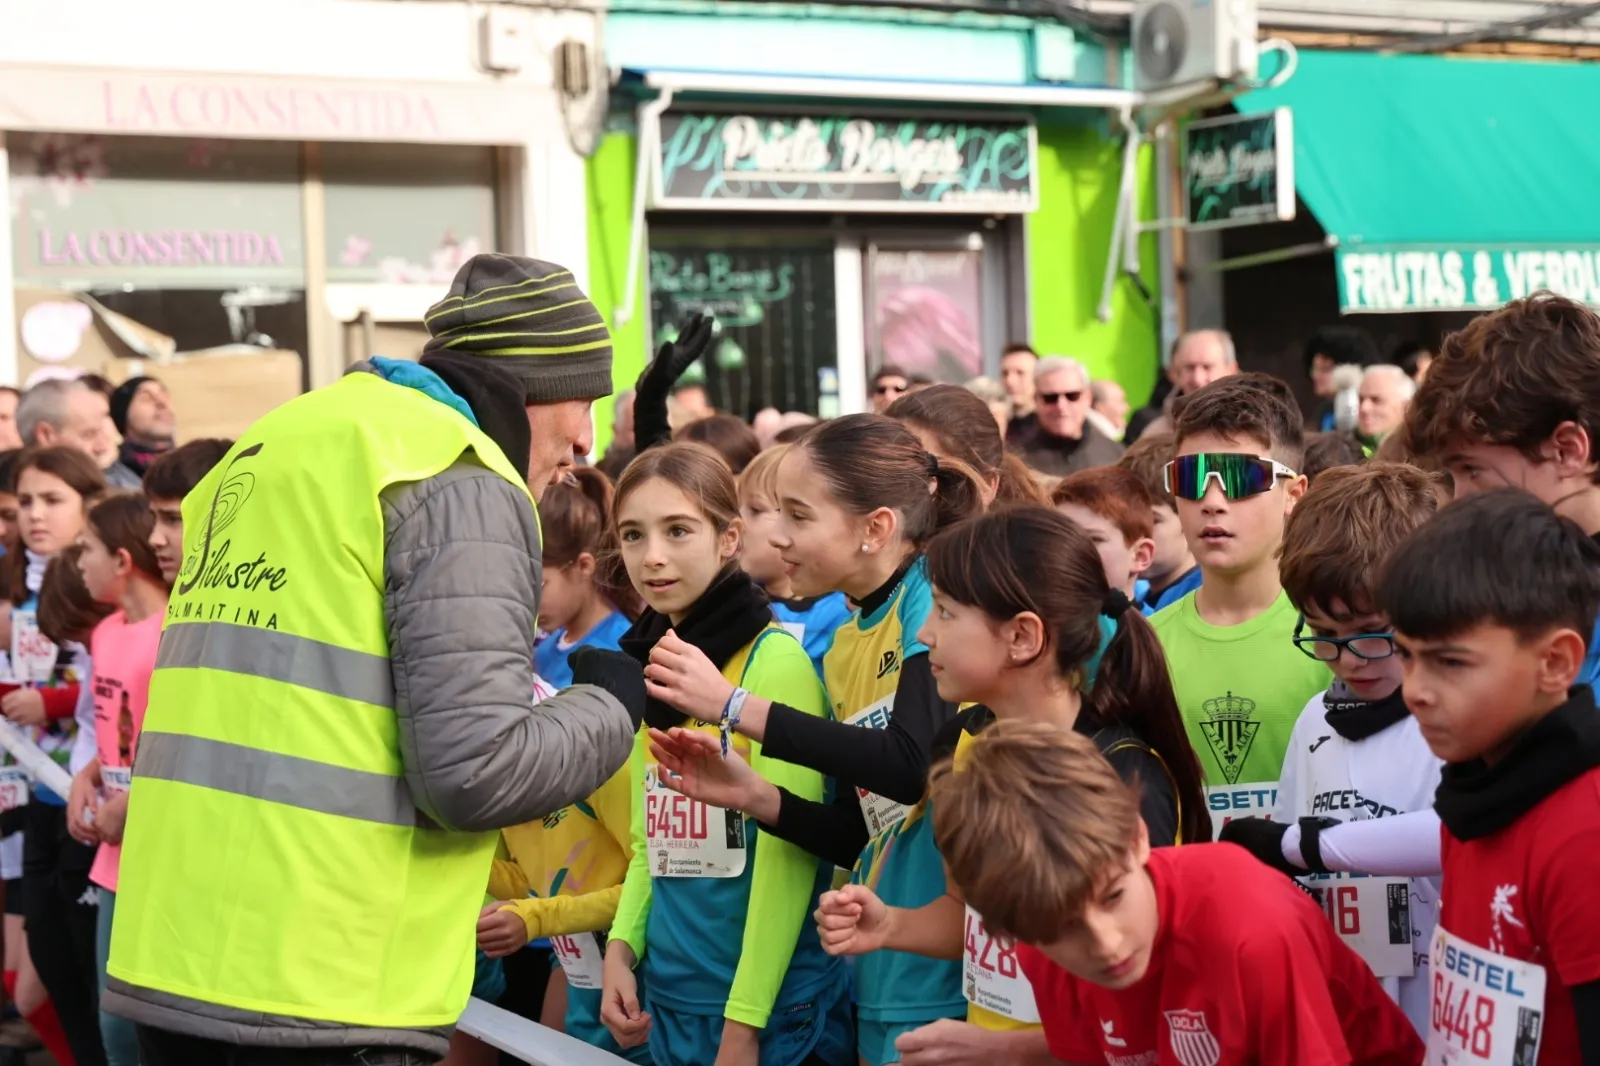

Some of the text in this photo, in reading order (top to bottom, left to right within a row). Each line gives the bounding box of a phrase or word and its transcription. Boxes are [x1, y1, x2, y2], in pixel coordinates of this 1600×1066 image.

[102, 80, 441, 136] LA CONSENTIDA
[39, 228, 284, 266] LA CONSENTIDA
[1341, 252, 1466, 310] FRUTAS
[1473, 251, 1500, 308] &
[646, 794, 708, 840] 6450
[1444, 944, 1525, 998] SETEL
[1432, 971, 1495, 1061] 6448
